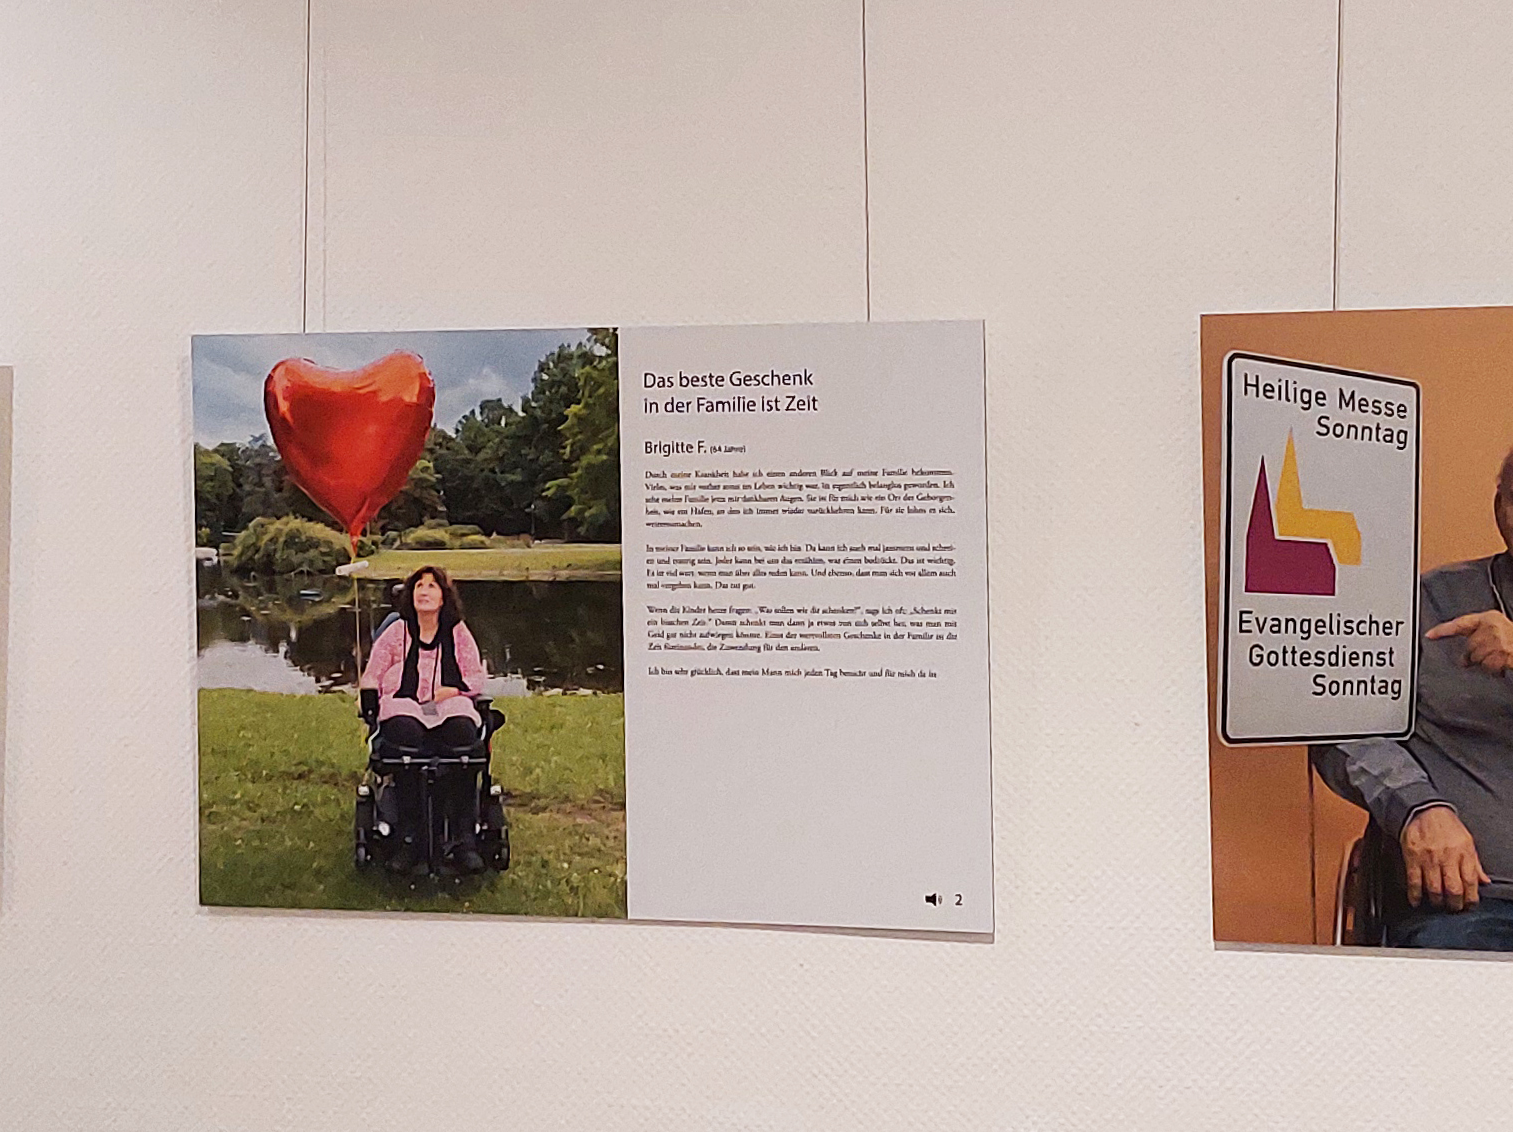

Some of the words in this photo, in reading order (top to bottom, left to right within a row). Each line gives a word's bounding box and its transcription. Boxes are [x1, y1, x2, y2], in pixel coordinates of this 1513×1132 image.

[643, 372, 674, 388] Das
[679, 371, 725, 388] beste
[729, 369, 814, 387] Geschenk
[644, 398, 659, 413] in
[664, 397, 691, 413] der
[696, 396, 757, 413] Familie
[760, 395, 780, 412] ist
[785, 395, 818, 412] Zeit
[1243, 373, 1327, 411] Heilige
[1338, 388, 1408, 420] Messe
[1315, 416, 1409, 450] Sonntag
[644, 441, 694, 457] Brigitte
[697, 440, 707, 454] F.
[1238, 611, 1405, 640] Evangelischer
[1248, 643, 1395, 668] Gottesdienst
[1311, 674, 1402, 701] Sonntag
[954, 894, 963, 906] 2
